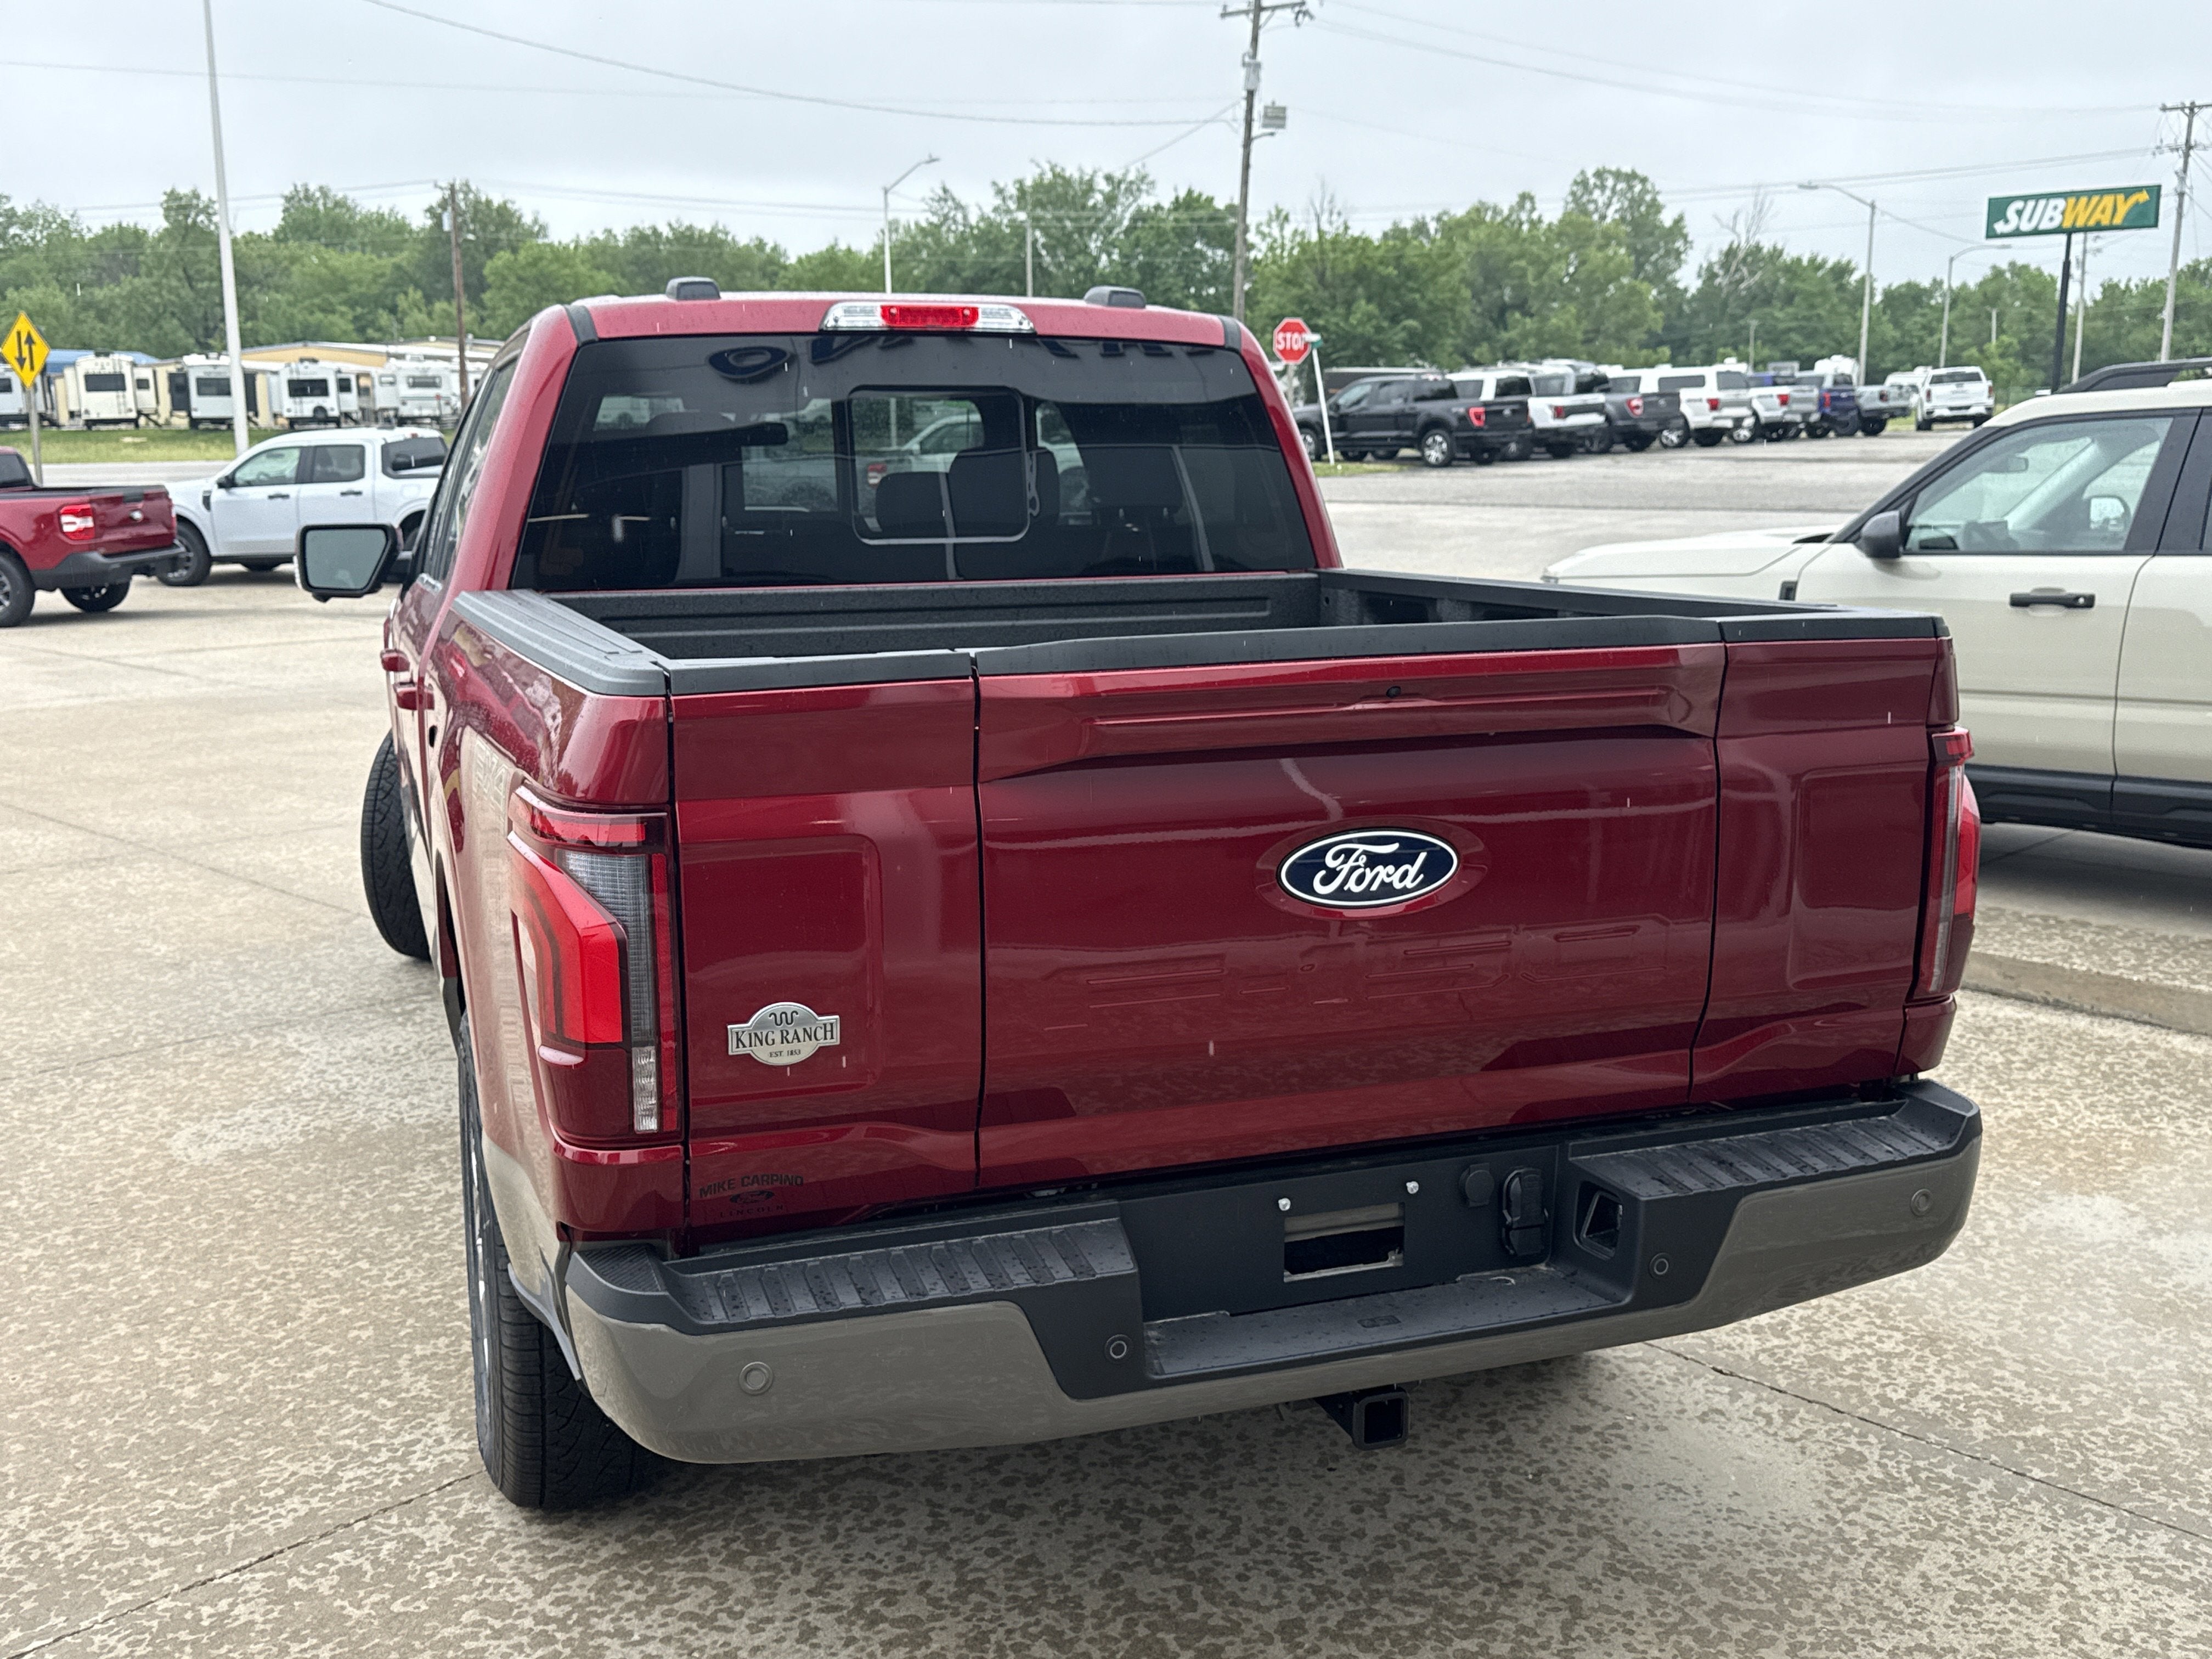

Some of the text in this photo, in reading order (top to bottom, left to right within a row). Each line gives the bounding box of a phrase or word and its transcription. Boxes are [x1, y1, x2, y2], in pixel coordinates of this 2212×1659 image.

[1993, 189, 2149, 234] SUBWAY
[1313, 843, 1427, 894] Ford
[735, 1023, 834, 1049] KING RANCH
[699, 1178, 736, 1198] MIKE
[741, 1173, 804, 1187] CARPINO
[720, 1205, 783, 1217] LINCOLN
